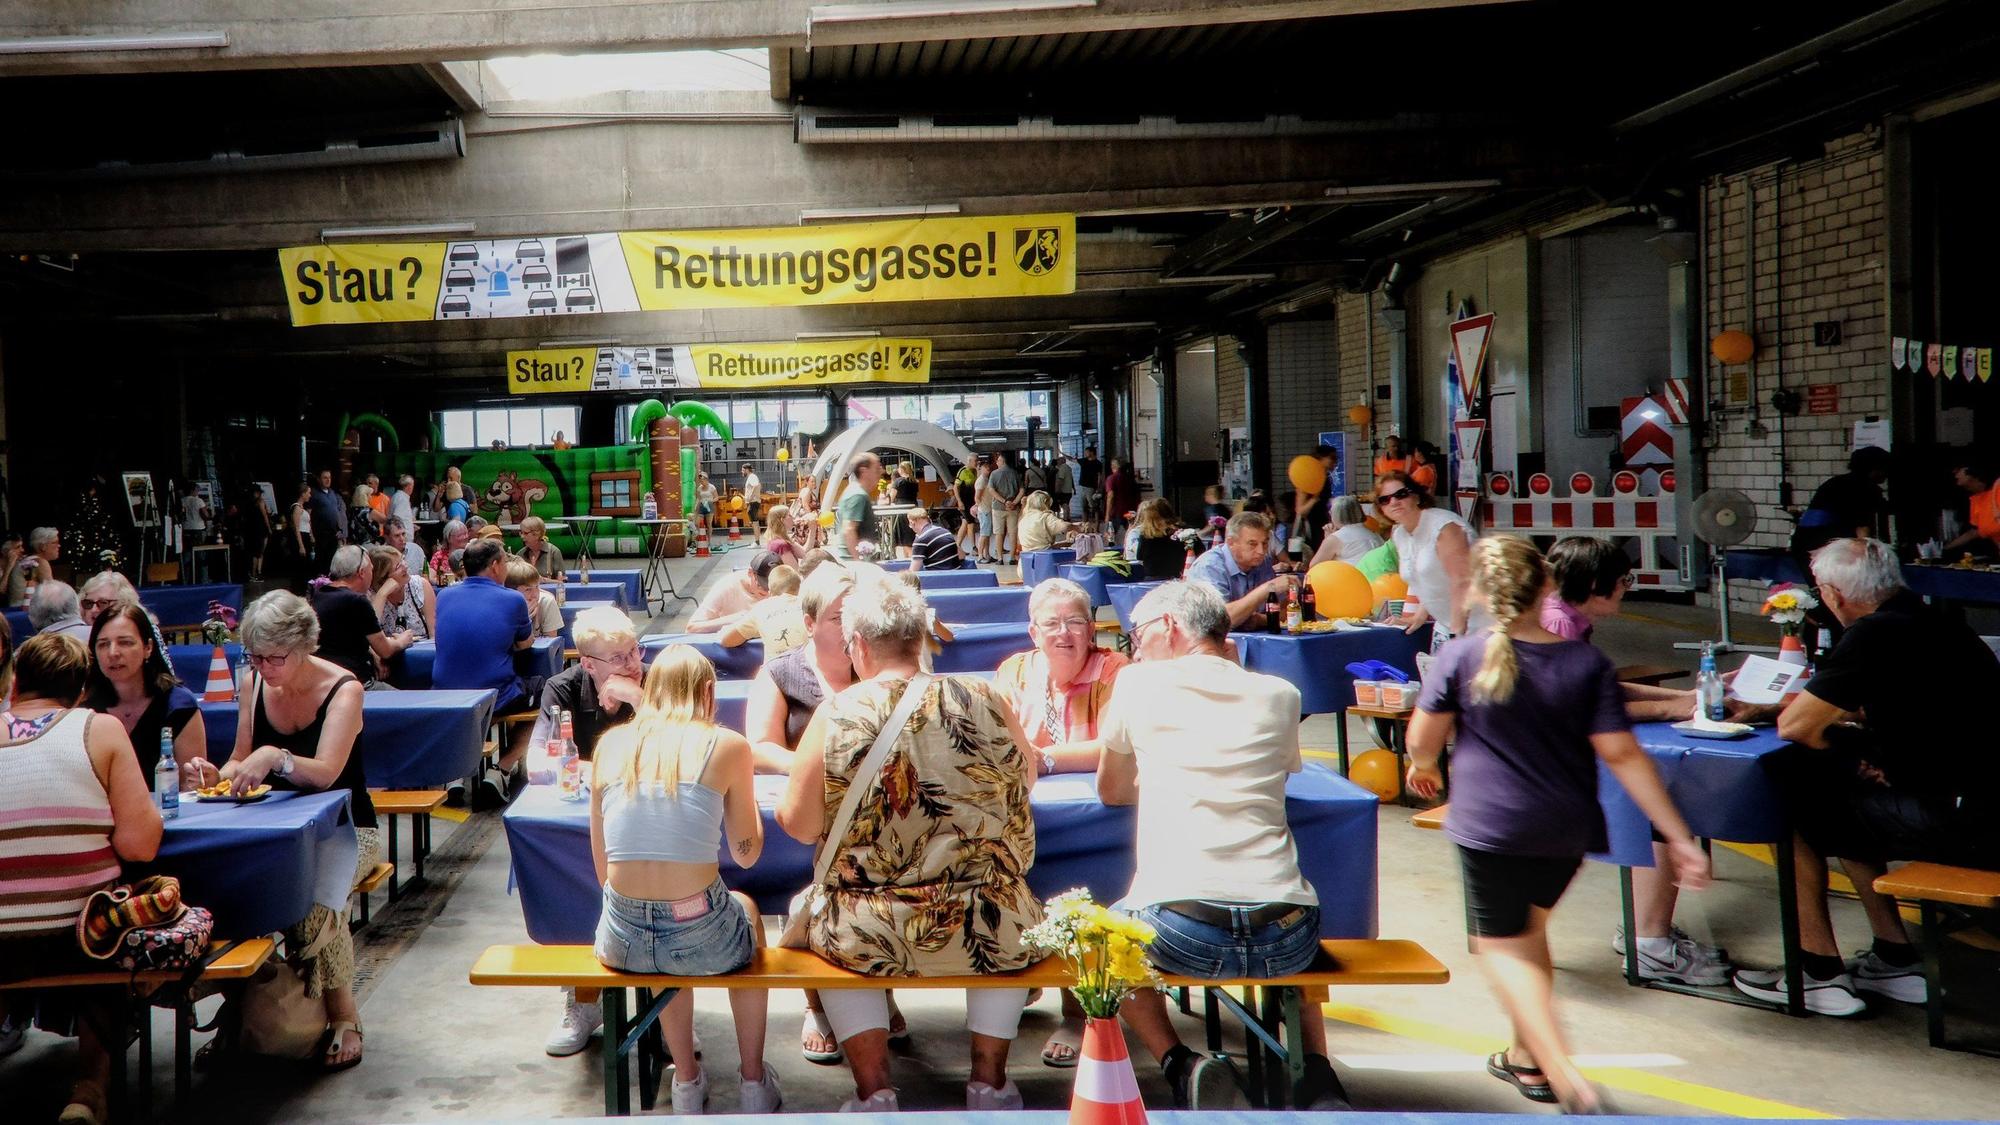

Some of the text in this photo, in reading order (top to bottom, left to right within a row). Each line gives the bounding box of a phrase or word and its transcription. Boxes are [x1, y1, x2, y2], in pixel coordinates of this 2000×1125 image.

[296, 231, 997, 306] Stau? Rettungsgasse!
[515, 347, 890, 383] Stau? Rettungsgasse!
